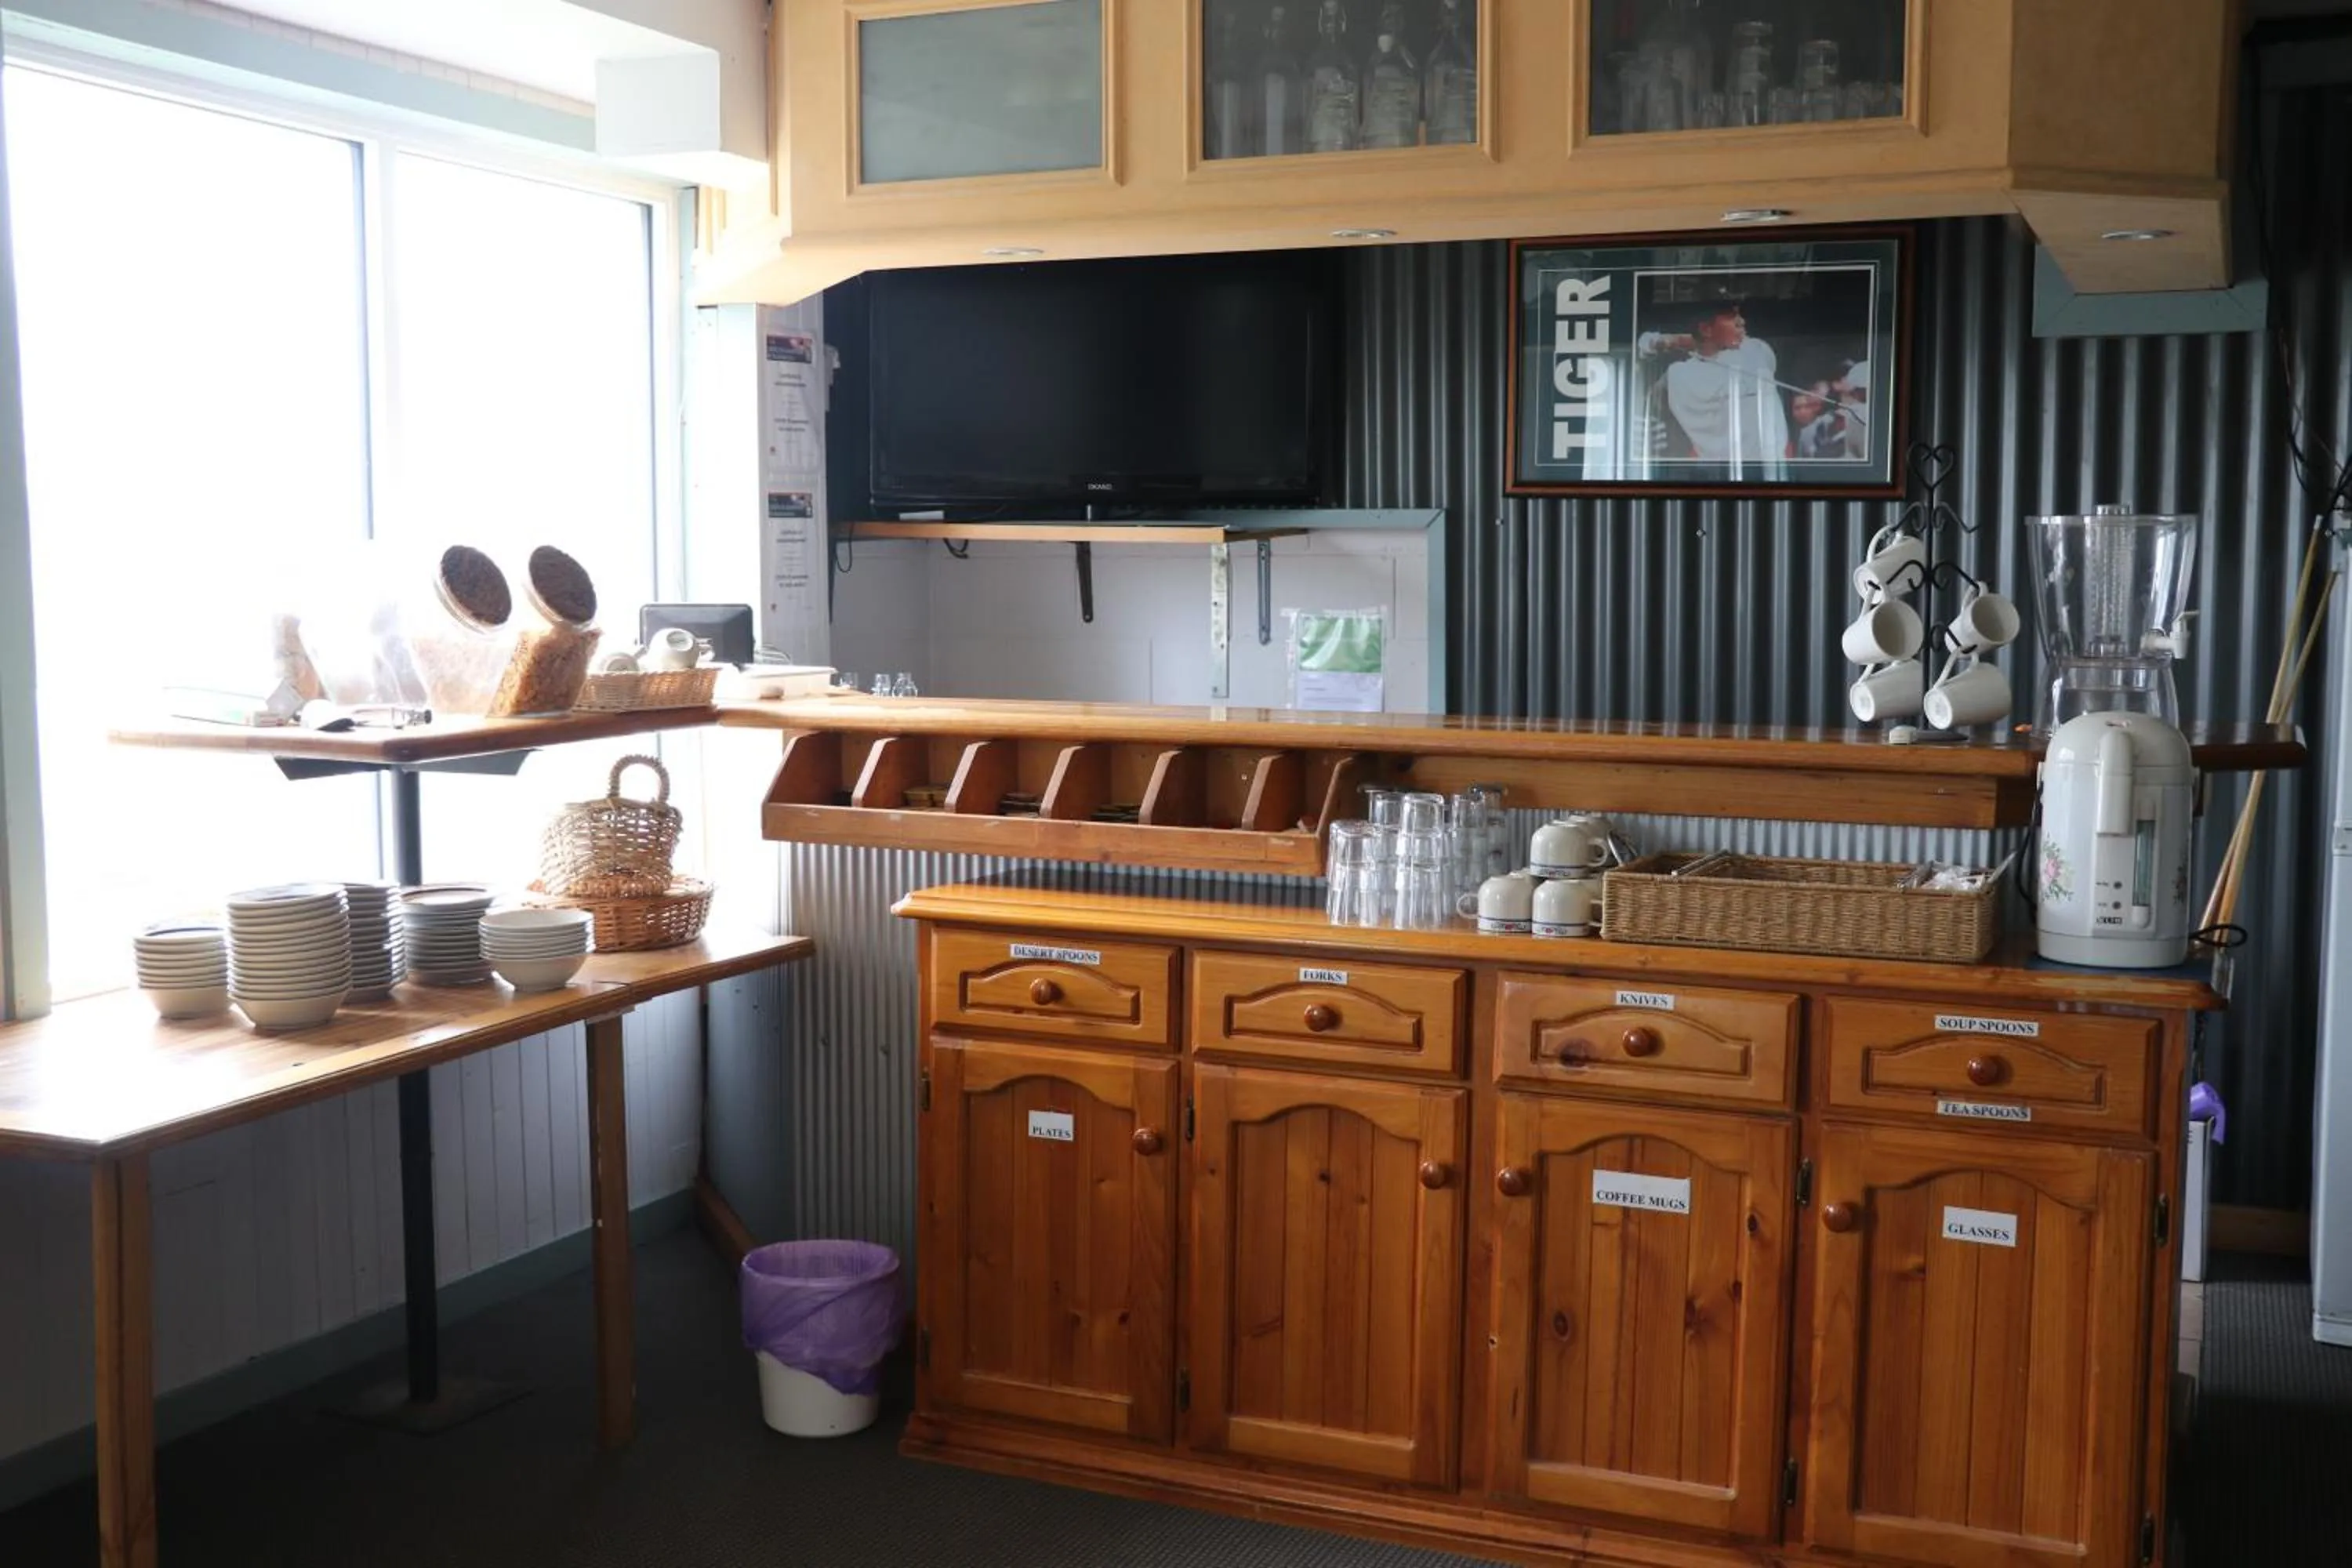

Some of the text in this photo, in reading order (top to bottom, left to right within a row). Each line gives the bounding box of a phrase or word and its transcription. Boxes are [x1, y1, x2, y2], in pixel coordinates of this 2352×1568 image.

[1553, 274, 1611, 459] TIGER
[1056, 948, 1098, 962] SPOONS
[1304, 970, 1343, 982] FORKS
[1620, 993, 1668, 1007] KNIVES
[1939, 1018, 2034, 1034] SOUP SPOONS
[1033, 1125, 1072, 1138] PLATES
[1596, 1190, 1686, 1209] COFFEE MUGS
[1947, 1222, 2010, 1241] GLASSES
